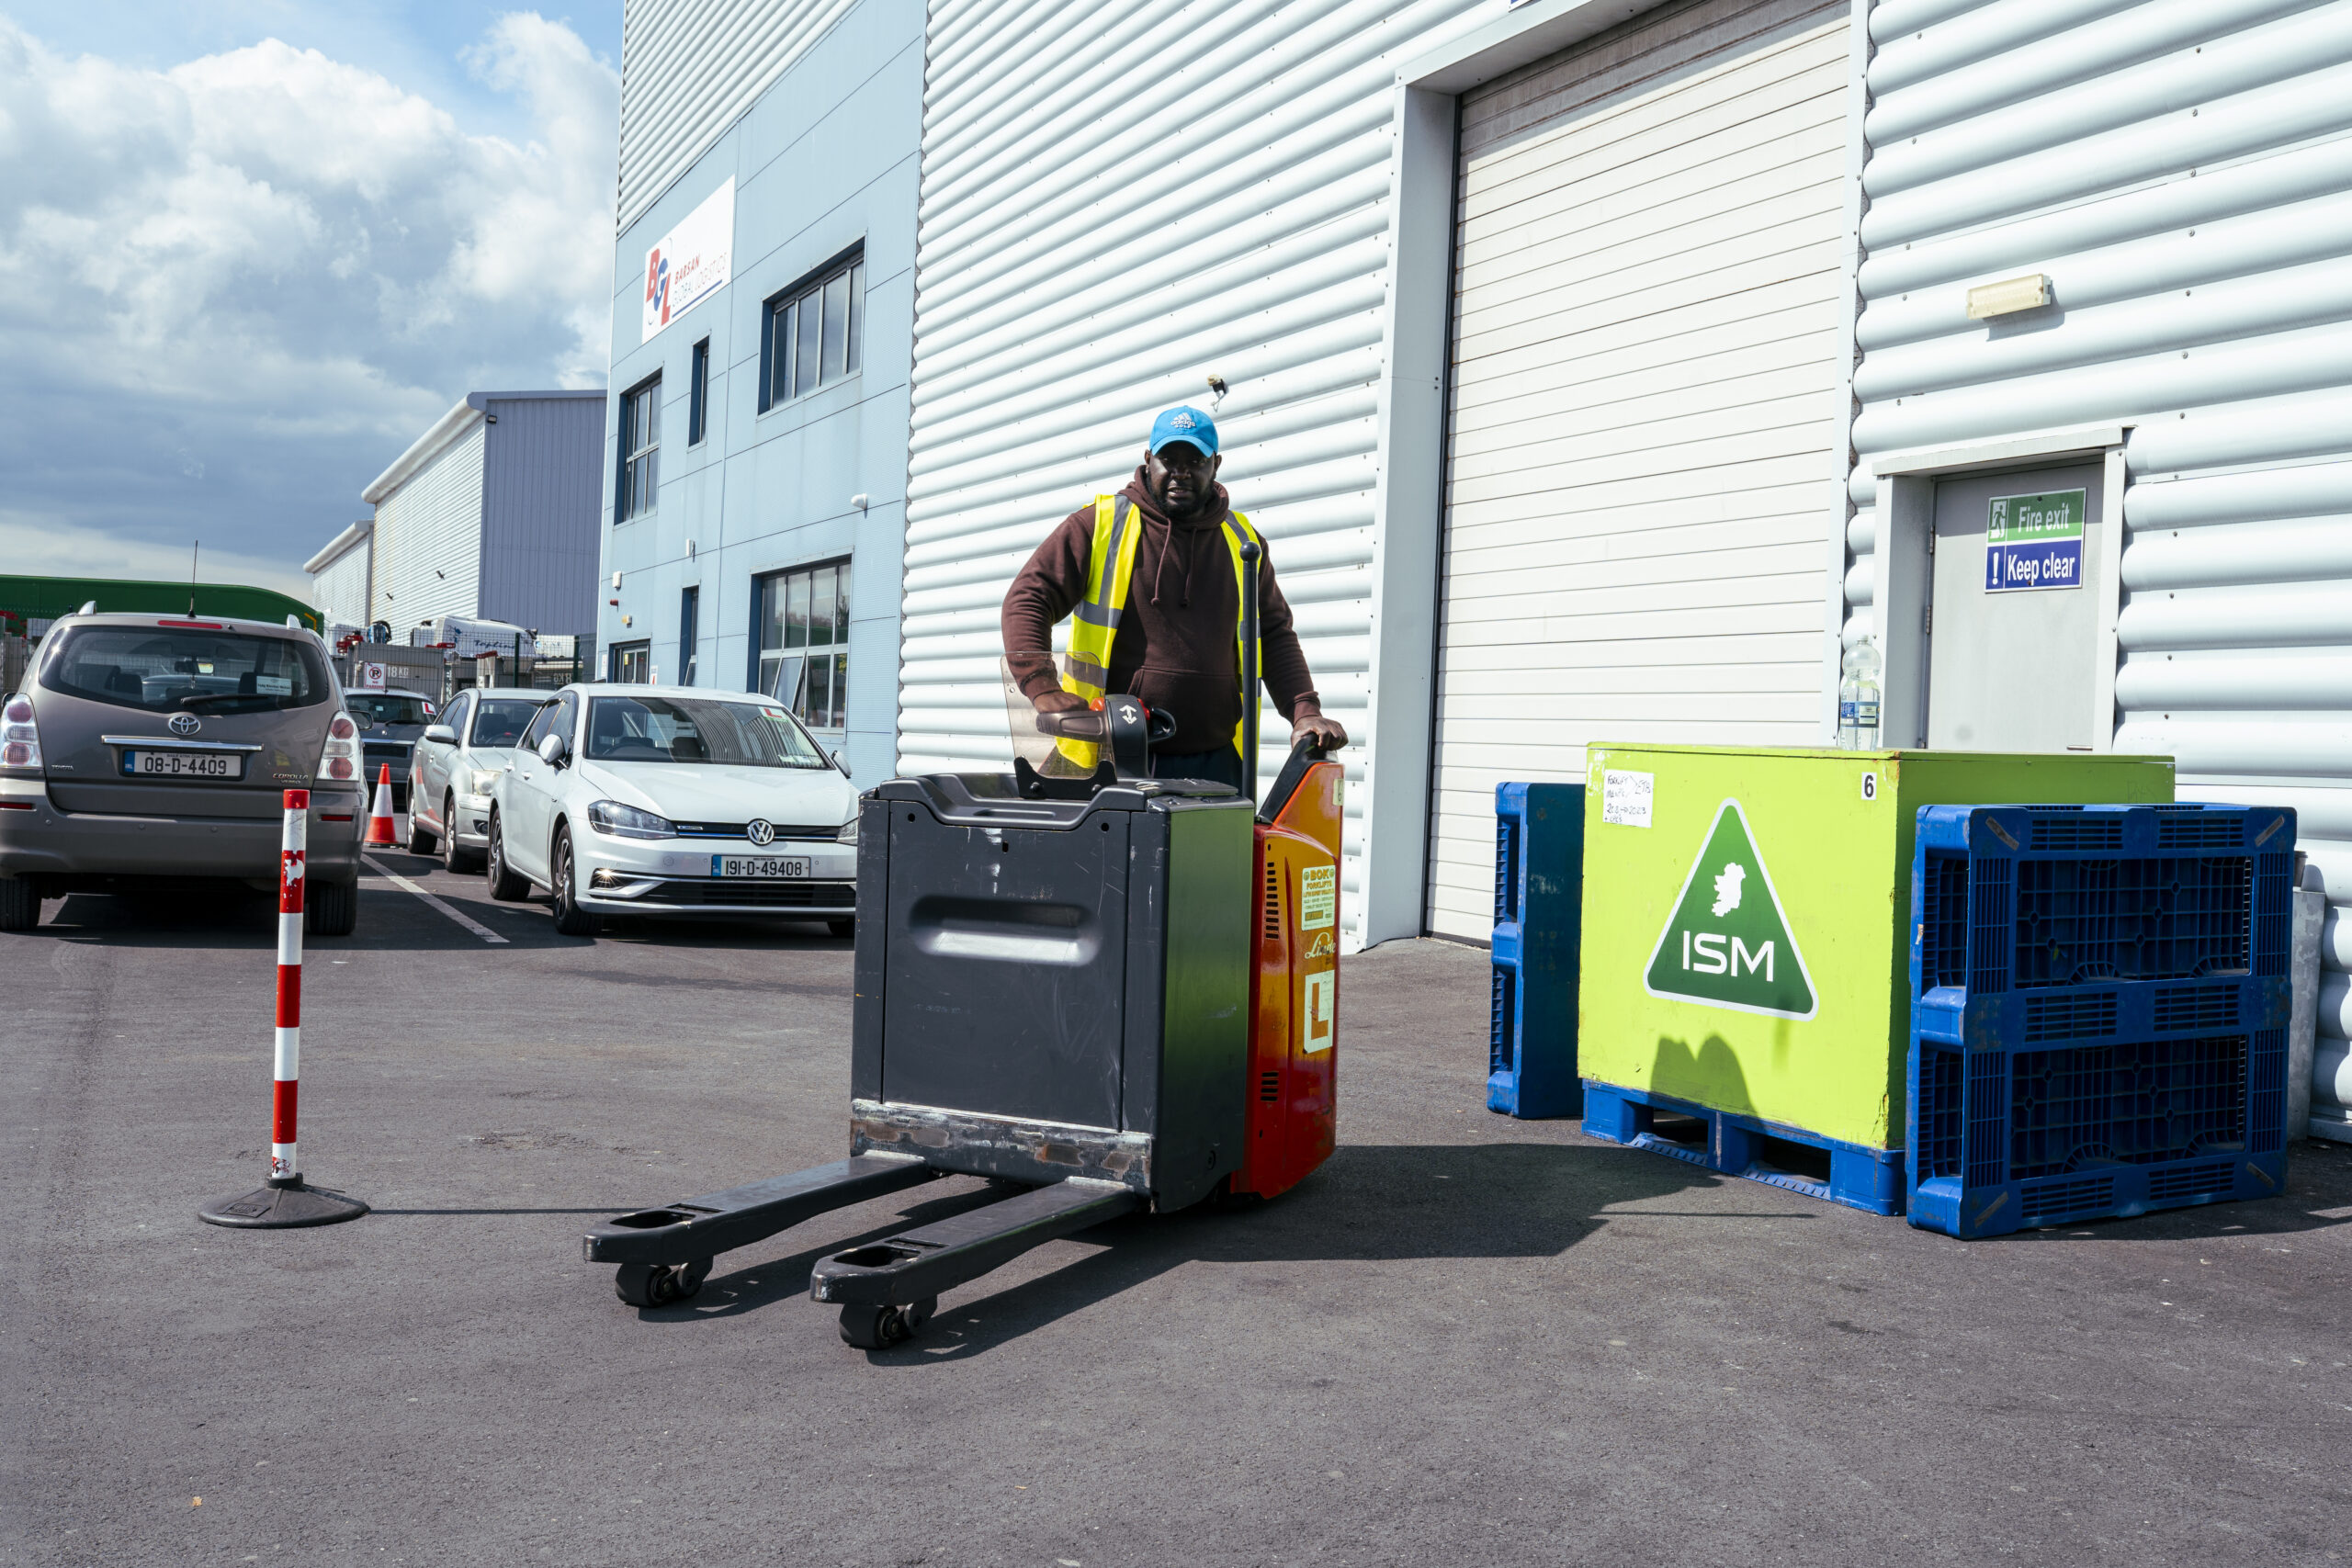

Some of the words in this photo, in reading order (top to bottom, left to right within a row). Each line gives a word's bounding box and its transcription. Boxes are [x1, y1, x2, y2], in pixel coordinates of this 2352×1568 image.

[674, 254, 701, 285] BARSAN
[646, 248, 671, 326] BGL
[1170, 419, 1196, 427] adidas
[2018, 506, 2042, 533] Fire
[2045, 502, 2070, 530] exit
[2007, 554, 2040, 586] Keep
[2042, 551, 2075, 579] clear
[387, 666, 398, 678] 18
[424, 703, 435, 714] L
[763, 707, 783, 718] L
[144, 757, 227, 774] 08-D-4409
[1864, 774, 1874, 797] 6
[726, 860, 802, 876] 191-D-49408
[1309, 868, 1329, 881] BOK
[1306, 880, 1332, 890] FORKLIFTS
[1305, 931, 1337, 960] Linde
[1682, 930, 1775, 983] ISM
[1311, 982, 1329, 1040] L
